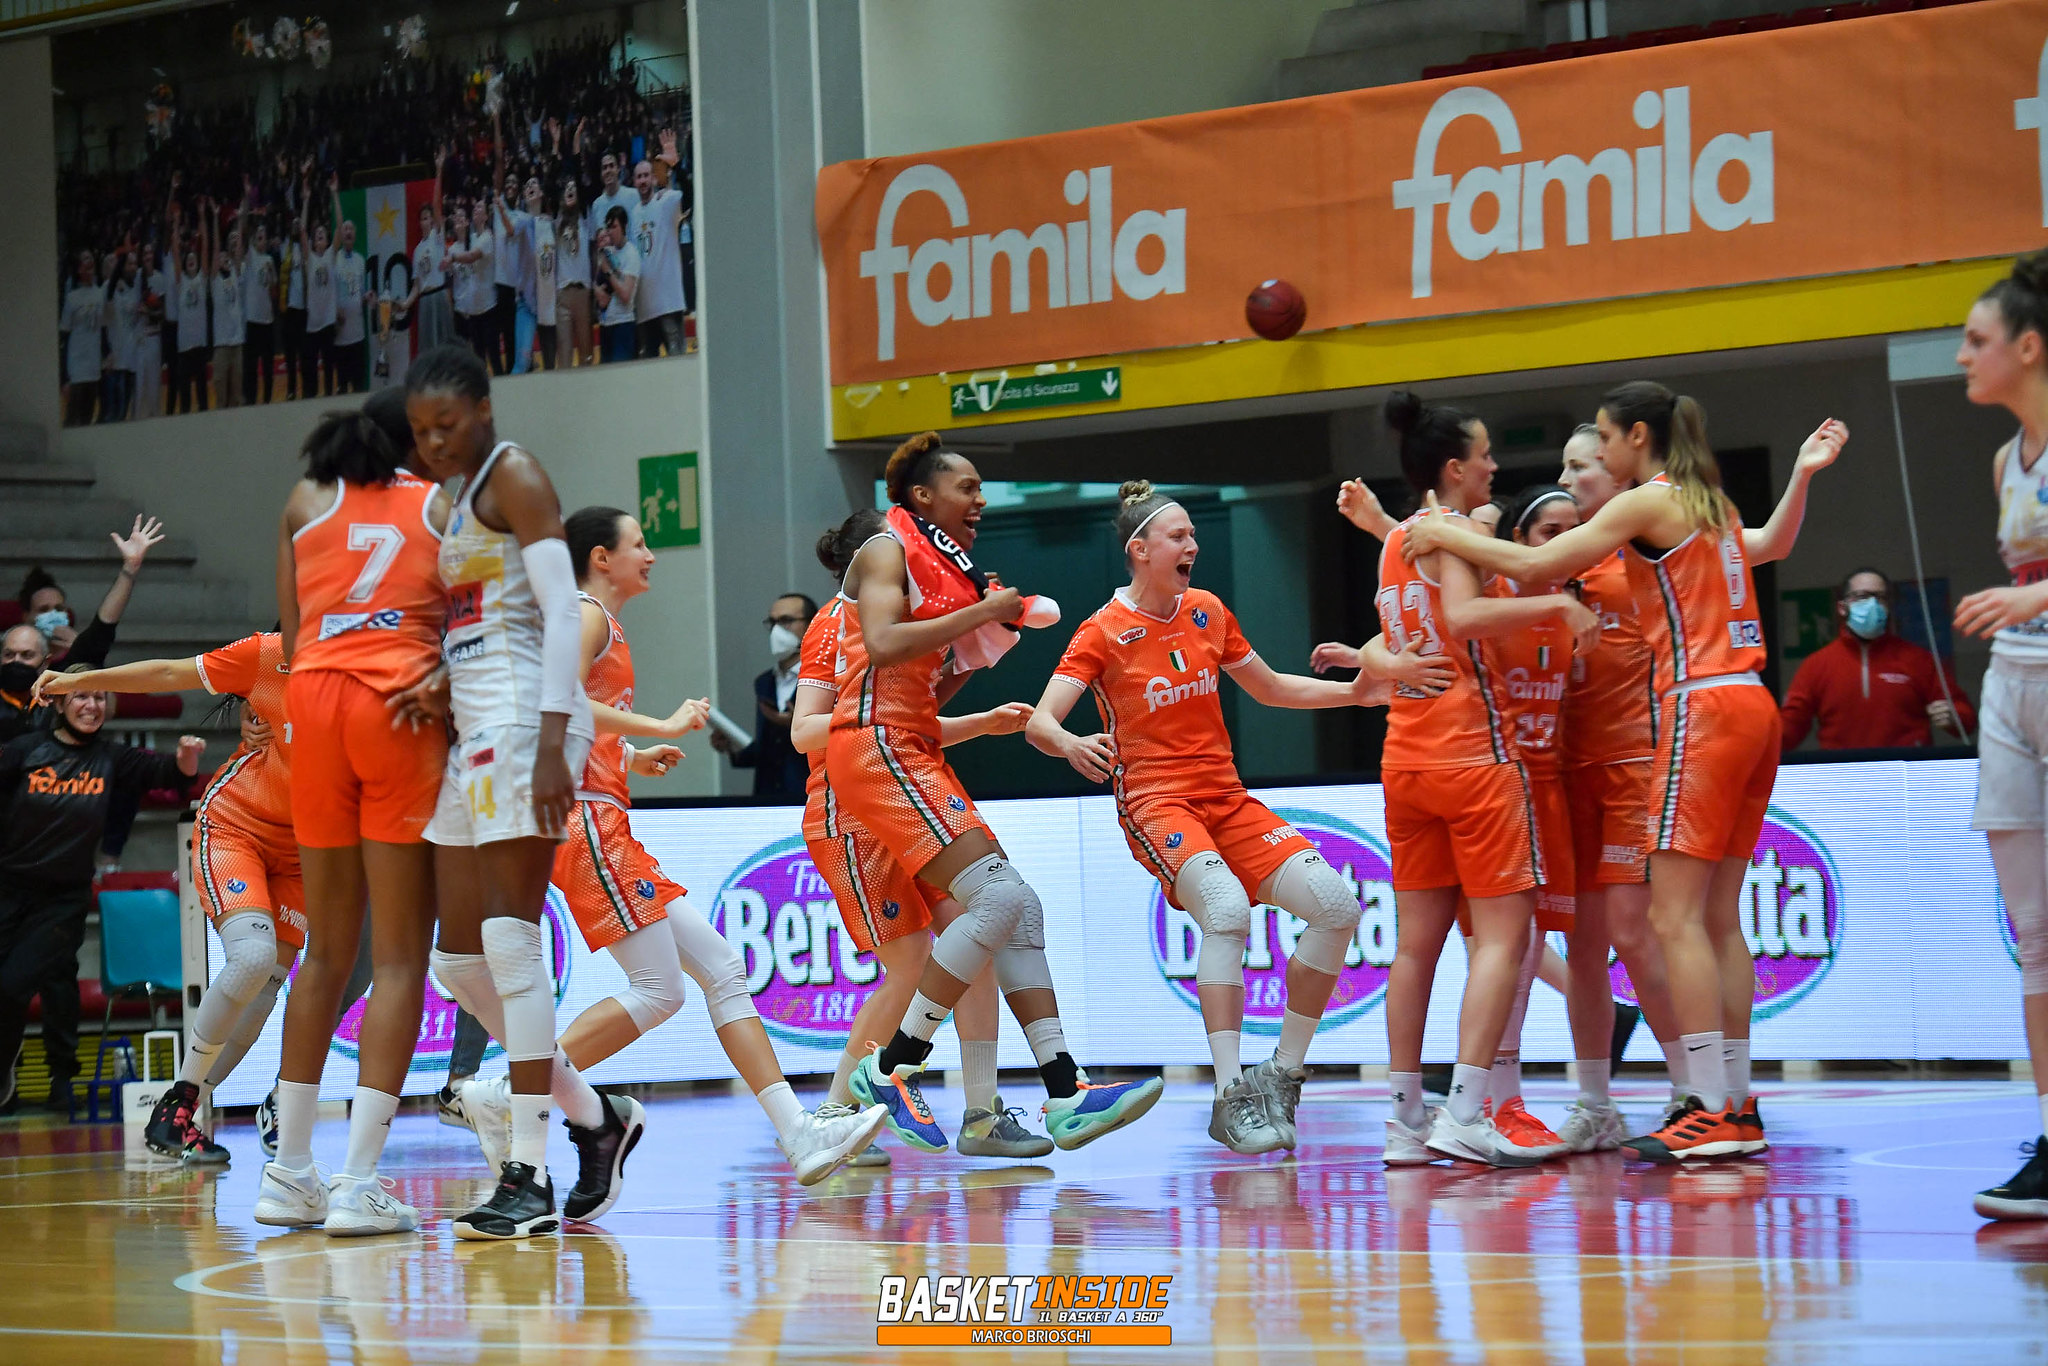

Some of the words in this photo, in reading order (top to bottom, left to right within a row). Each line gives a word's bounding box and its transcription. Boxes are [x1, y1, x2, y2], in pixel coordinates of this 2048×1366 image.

[1393, 86, 1774, 298] famila
[860, 163, 1187, 361] famila
[346, 523, 406, 603] 7
[467, 775, 497, 823] 14
